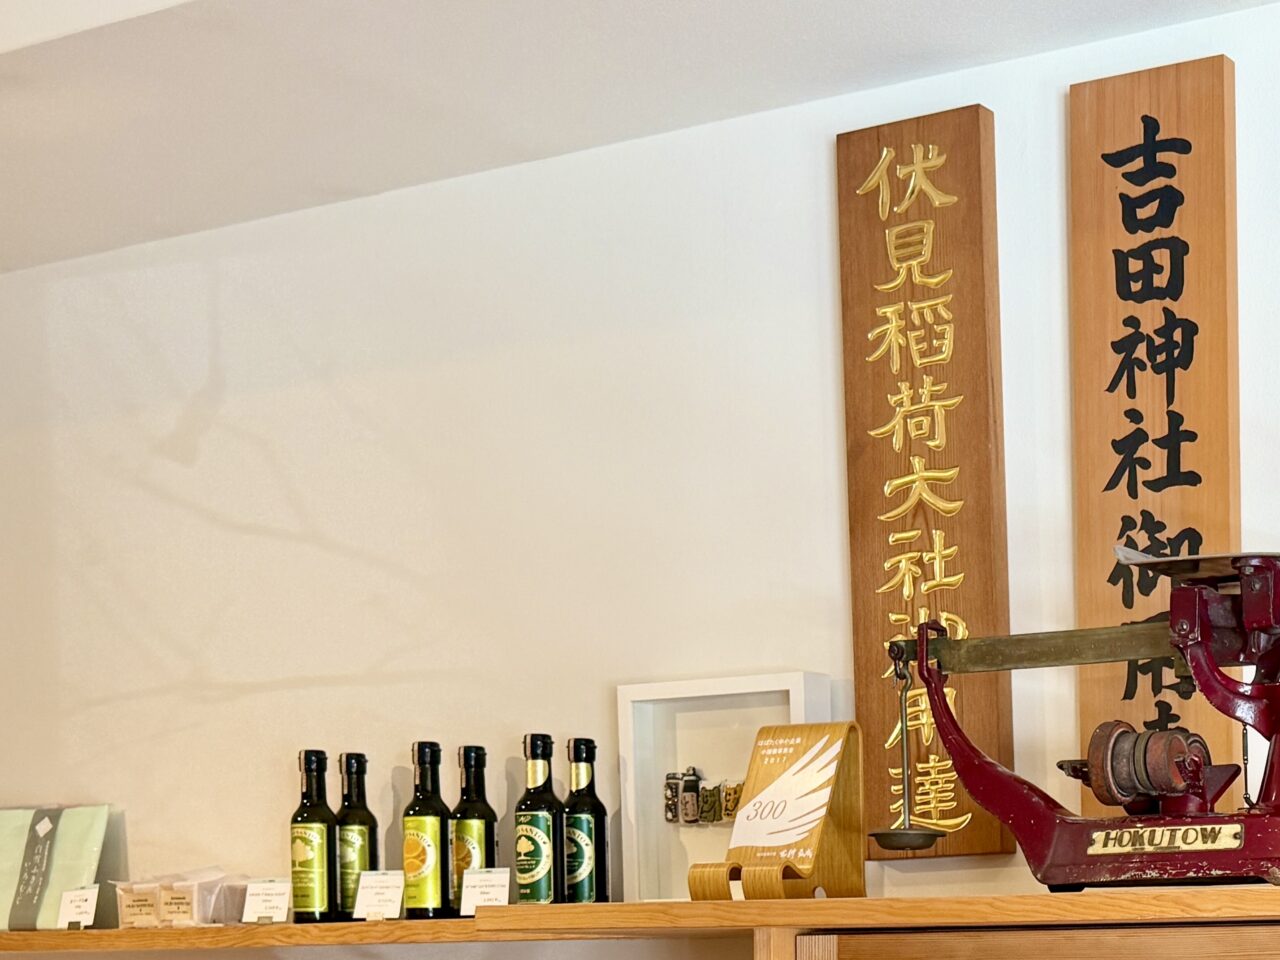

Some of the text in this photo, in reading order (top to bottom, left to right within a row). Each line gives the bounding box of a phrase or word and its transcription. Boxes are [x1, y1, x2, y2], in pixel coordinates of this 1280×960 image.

[763, 756, 787, 764] 2017
[746, 799, 788, 822] 300
[1102, 826, 1223, 849] HOKUTOW
